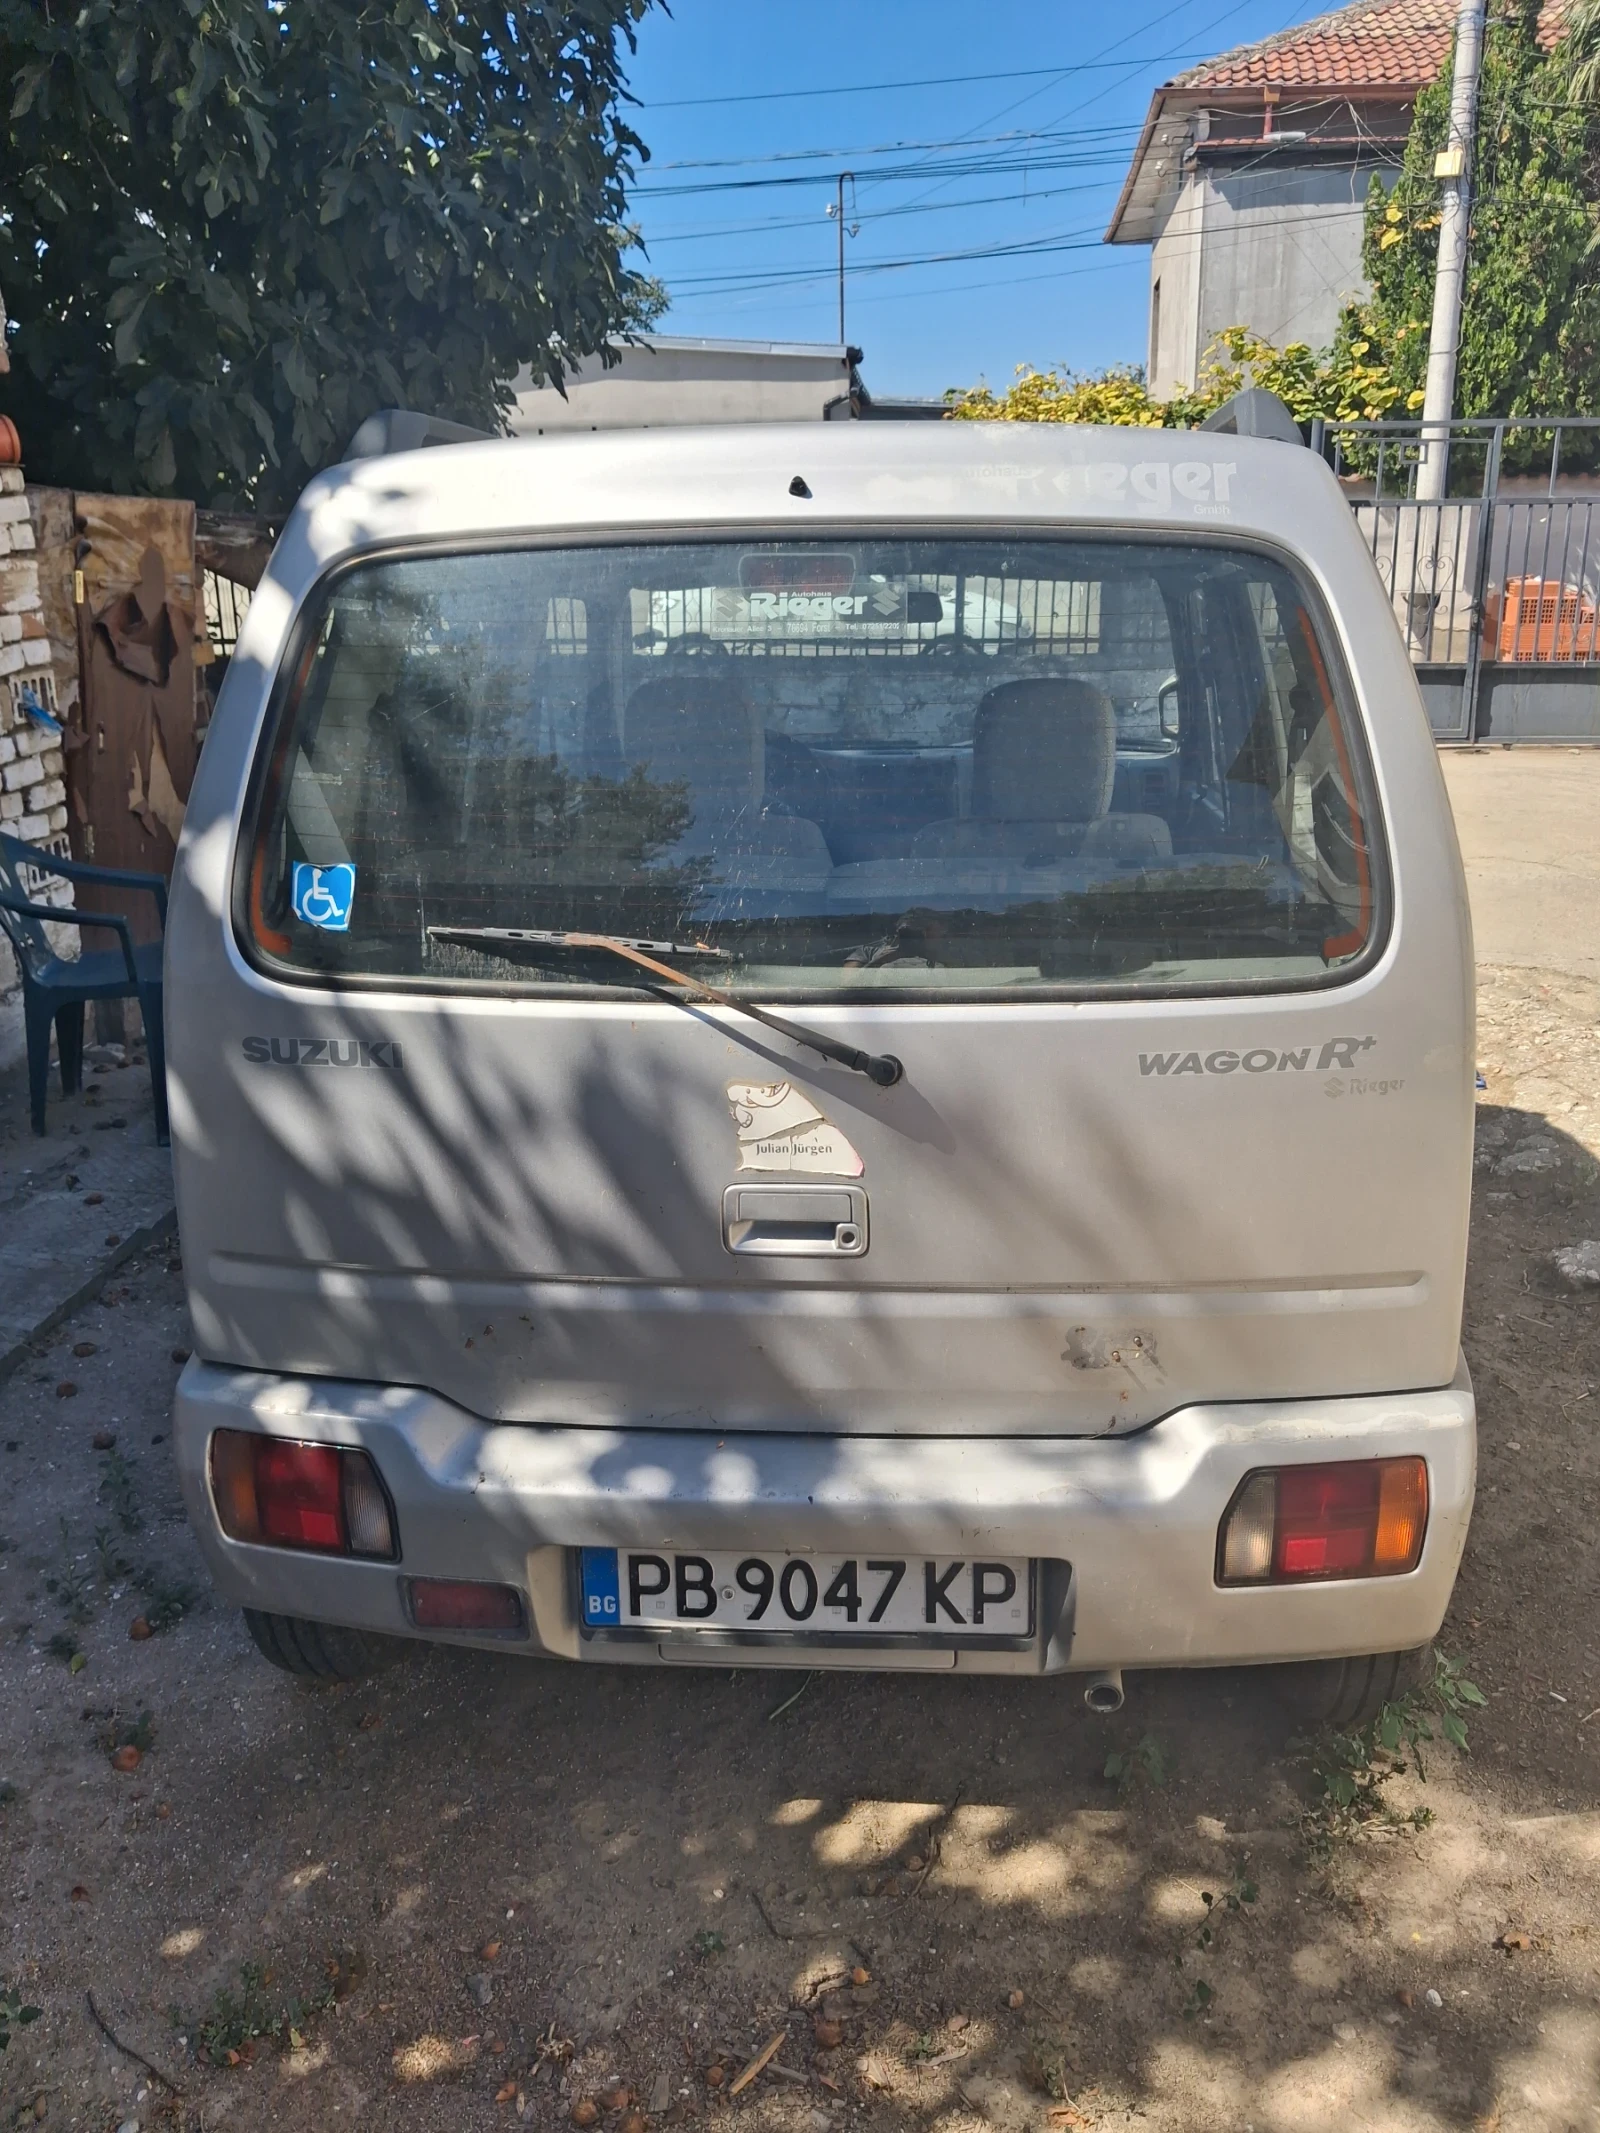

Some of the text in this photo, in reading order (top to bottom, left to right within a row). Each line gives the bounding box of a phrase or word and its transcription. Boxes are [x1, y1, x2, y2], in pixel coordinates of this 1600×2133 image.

[1193, 503, 1231, 516] Gmbh
[750, 592, 869, 621] Rieger
[242, 1036, 403, 1069] SUZUKI
[1138, 1035, 1377, 1076] WAGON R+
[1349, 1078, 1406, 1096] Rieger
[756, 1142, 832, 1156] Julian Jürgen
[628, 1554, 1017, 1625] PB 9047 KP
[589, 1595, 617, 1614] BG
